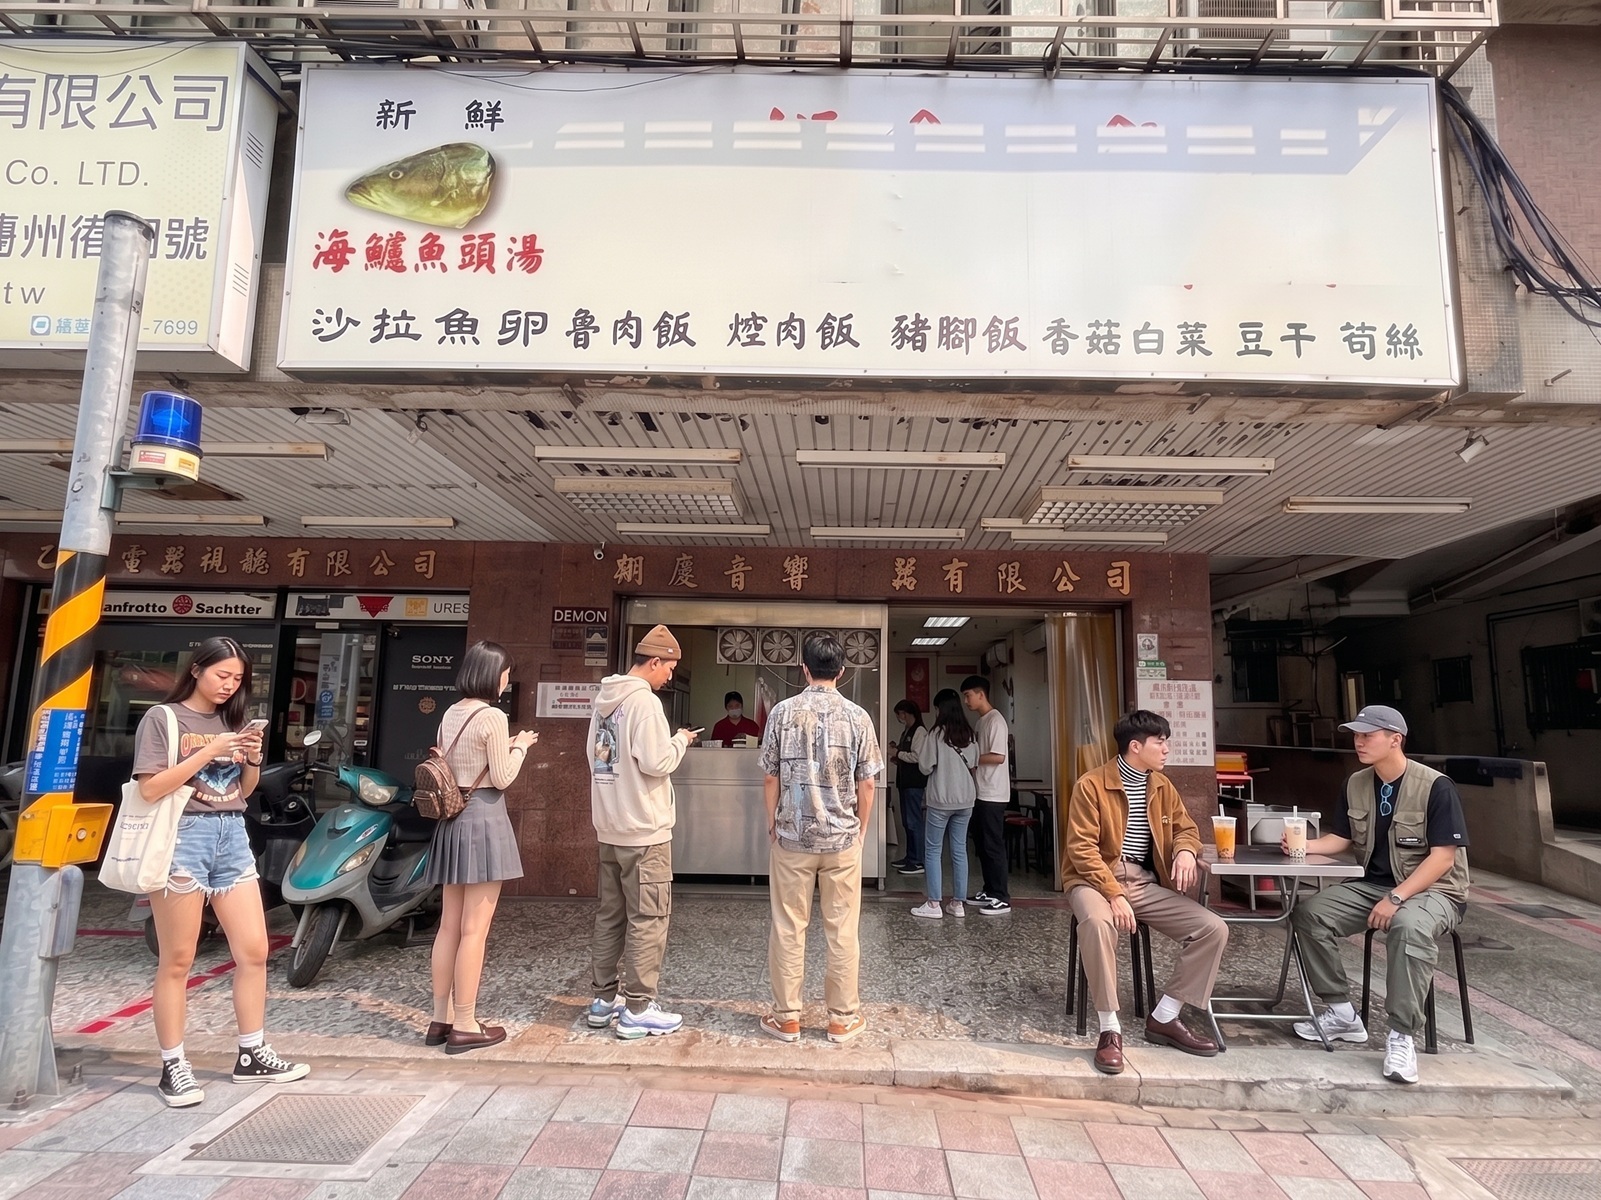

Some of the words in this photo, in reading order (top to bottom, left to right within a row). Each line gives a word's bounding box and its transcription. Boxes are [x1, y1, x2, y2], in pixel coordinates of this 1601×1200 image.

[0, 73, 229, 131] 有限公司
[376, 99, 504, 132] 新鮮
[6, 160, 58, 185] Co.
[79, 161, 149, 186] LTD.
[312, 228, 545, 274] 海鱸魚頭湯
[312, 308, 549, 347] 沙拉魚卵
[565, 308, 697, 350] 魯肉飯
[890, 312, 1028, 355] 豬腳飯
[1042, 317, 1213, 357] 香菇白菜
[1236, 322, 1317, 358] 豆干
[101, 601, 167, 613] anfrotto
[195, 603, 262, 615] Sachtter
[554, 610, 607, 622] DEMON
[412, 655, 454, 664] SONY
